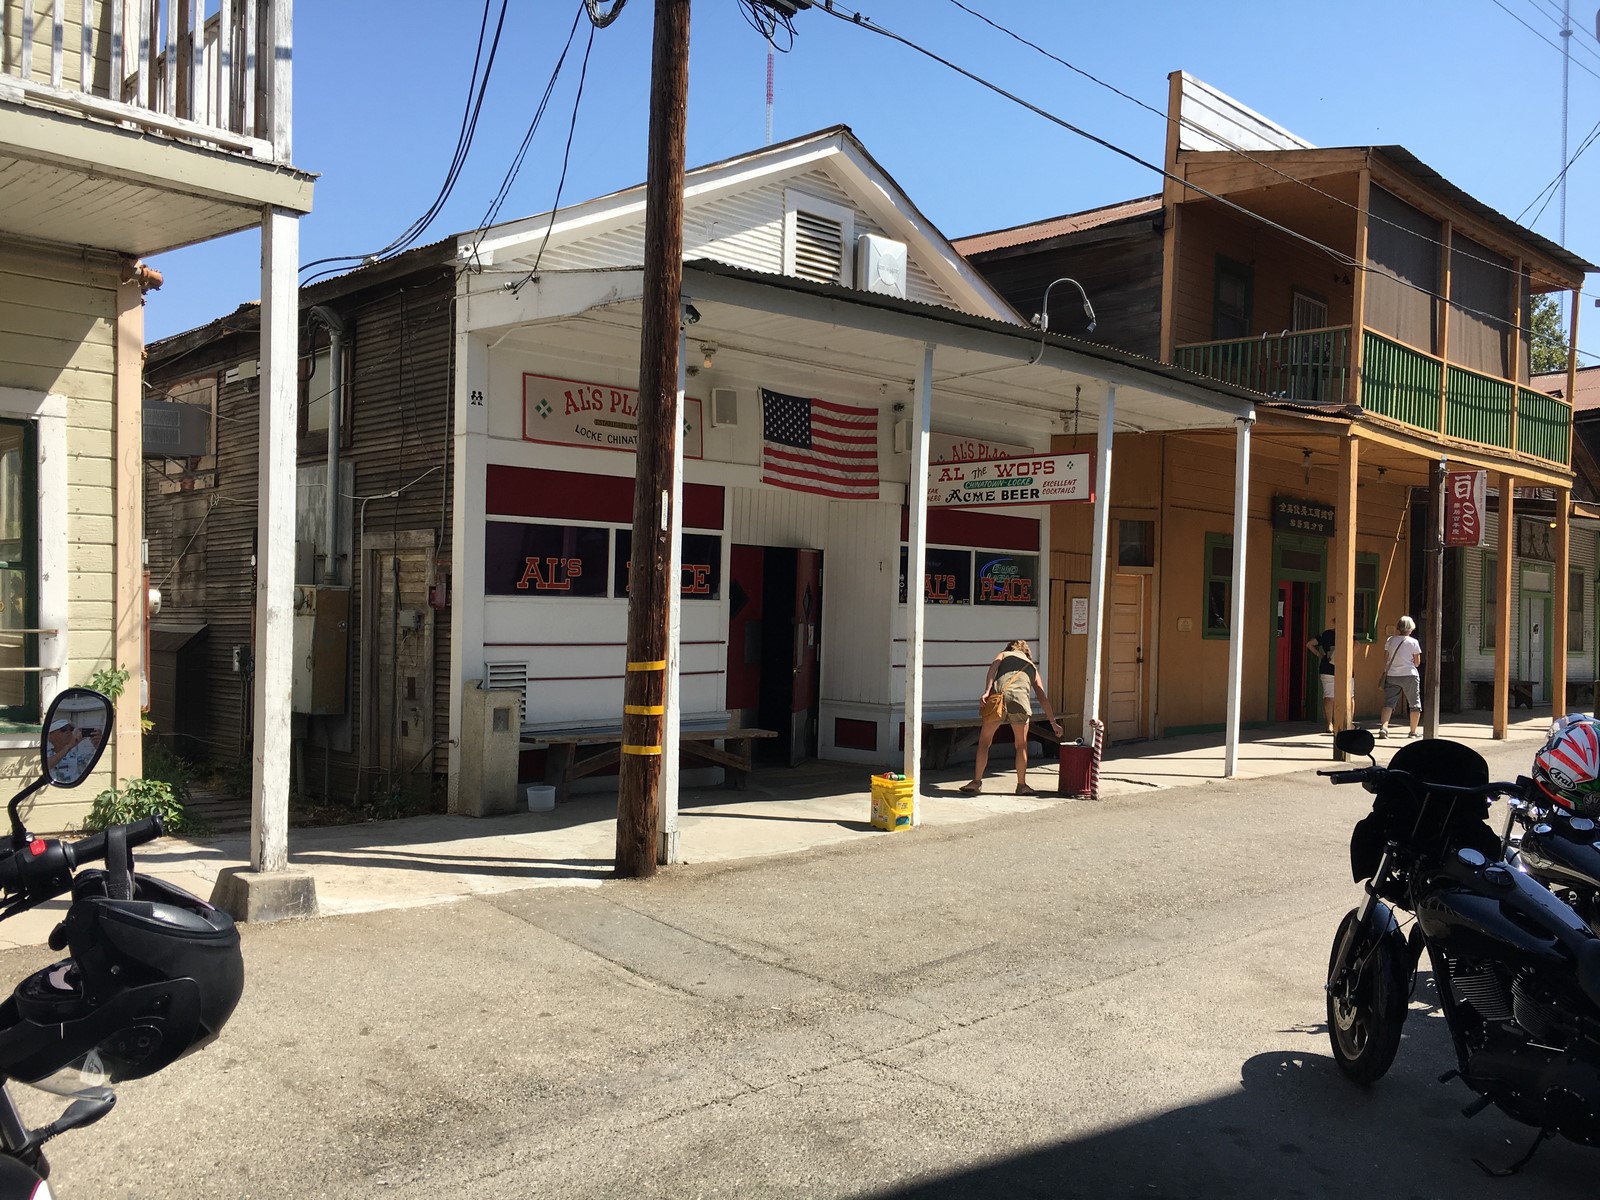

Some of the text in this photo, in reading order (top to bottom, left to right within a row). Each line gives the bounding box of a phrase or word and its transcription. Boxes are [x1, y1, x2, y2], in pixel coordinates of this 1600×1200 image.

[564, 386, 604, 416] AL'S
[575, 424, 603, 442] LOCKE
[951, 440, 975, 461] AL'S
[938, 467, 965, 482] AL
[994, 461, 1056, 478] WOPS
[1041, 486, 1076, 495] COCKTAILS
[1042, 478, 1078, 488] EXCELLENT
[945, 488, 1040, 504] ACME BEER
[980, 577, 1032, 602] PLACE
